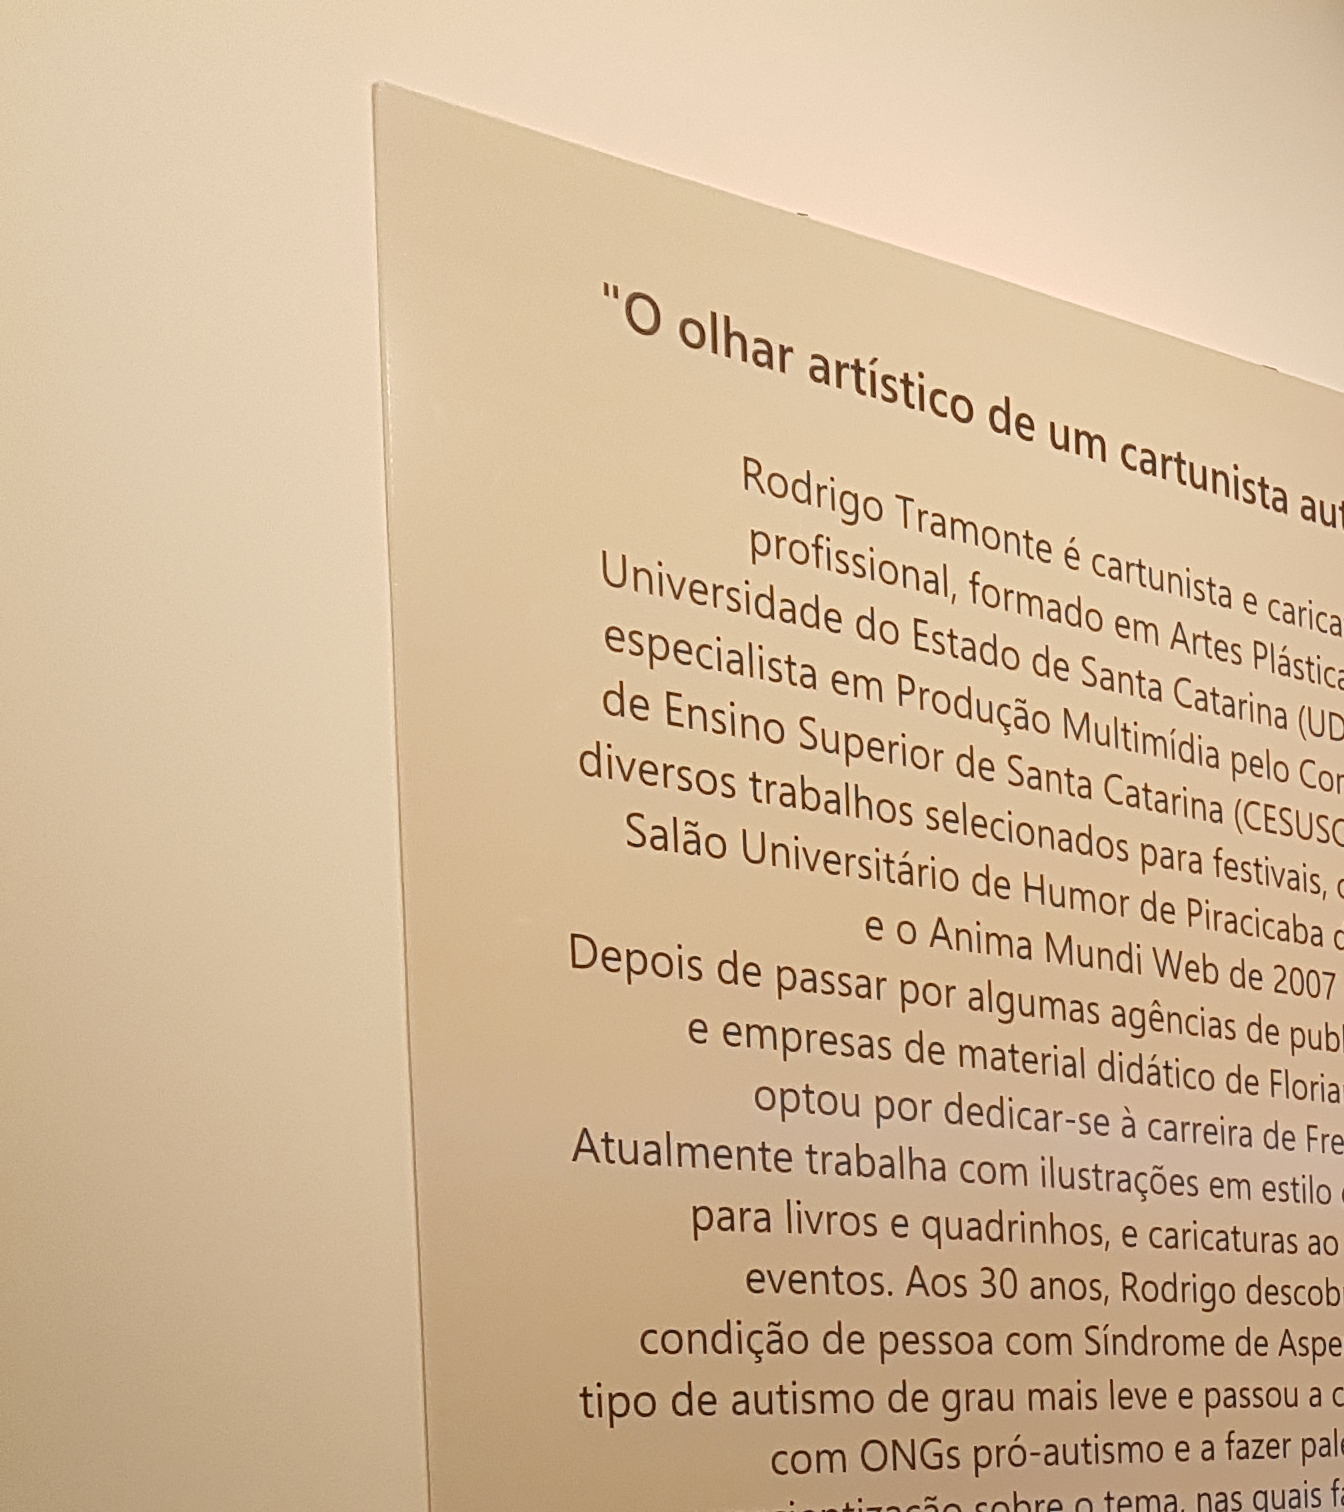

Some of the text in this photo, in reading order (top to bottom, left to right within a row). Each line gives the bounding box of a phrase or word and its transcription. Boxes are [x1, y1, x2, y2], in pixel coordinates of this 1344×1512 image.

[602, 280, 662, 337] "O
[677, 309, 795, 375] olhar
[807, 352, 975, 425] artístico
[987, 394, 1036, 443] de
[1048, 420, 1108, 464] um
[1119, 442, 1289, 516] cartunista
[742, 454, 884, 527] Rodrigo
[893, 492, 1053, 565] Tramonte
[1090, 552, 1233, 610] cartunista
[600, 549, 843, 635] Universidade
[854, 605, 900, 646] do
[912, 616, 1021, 672] Estado
[1080, 654, 1163, 703] Santa
[1172, 675, 1288, 731] Catarina
[749, 528, 957, 606] profissional,
[967, 569, 1104, 633] formado
[1113, 614, 1160, 647] em
[1168, 620, 1243, 667] Artes
[601, 679, 650, 722] de
[665, 689, 786, 745] Ensino
[797, 714, 945, 773] Superior
[954, 743, 996, 783] de
[1006, 753, 1093, 801] Santa
[1102, 772, 1224, 825] Catarina
[603, 624, 818, 691] especialista
[830, 668, 884, 704] em
[896, 672, 1052, 737] Produção
[1062, 706, 1220, 770] Multimídia
[1230, 747, 1290, 784] pelo
[578, 739, 737, 800] diversos
[747, 770, 914, 828] trabalhos
[924, 800, 1130, 863] selecionados
[1139, 841, 1203, 876] para
[1211, 845, 1328, 902] festivais,
[625, 811, 728, 860] Salão
[741, 827, 960, 893] Universitário
[1022, 870, 1131, 918] Humor
[1139, 888, 1177, 926] de
[1186, 896, 1325, 948] Piracicaba
[569, 931, 704, 986] Depois
[716, 948, 762, 989] de
[775, 964, 888, 1002] passar
[898, 978, 957, 1014] por
[967, 978, 1101, 1026] algumas
[1110, 998, 1237, 1042] agências
[1245, 1011, 1280, 1047] de
[928, 915, 1033, 962] Anima
[1044, 930, 1142, 976] Mundi
[1150, 945, 1220, 986] Web
[1272, 962, 1337, 1001] 2007
[721, 1020, 893, 1063] empresas
[957, 1042, 1086, 1080] material
[1096, 1048, 1216, 1092] didático
[1224, 1062, 1260, 1097] de
[570, 1126, 794, 1174] Atualmente
[803, 1141, 947, 1183] trabalha
[958, 1158, 1029, 1188] com
[1039, 1154, 1200, 1203] ilustrações
[1208, 1175, 1252, 1201] em
[1260, 1173, 1333, 1206] estilo
[753, 1082, 861, 1124] optou
[874, 1094, 933, 1130] por
[943, 1090, 1110, 1137] dedicar-se
[1146, 1114, 1253, 1149] carreira
[1262, 1118, 1297, 1152] de
[691, 1204, 772, 1243] para
[785, 1197, 879, 1238] livros
[920, 1207, 1111, 1253] quadrinhos,
[1147, 1218, 1299, 1256] caricaturas
[1306, 1233, 1340, 1257] ao
[744, 1264, 894, 1297] eventos.
[904, 1264, 968, 1299] Aos
[979, 1265, 1019, 1300] 30
[1028, 1275, 1110, 1307] anos,
[1120, 1270, 1236, 1314] Rodrigo
[638, 1317, 810, 1365] condição
[878, 1329, 994, 1366] pessoa
[1004, 1331, 1073, 1357] com
[1083, 1322, 1226, 1357] Síndrome
[1234, 1325, 1269, 1358] de
[577, 1380, 657, 1430] tipo
[670, 1379, 718, 1417] de
[730, 1378, 875, 1417] autismo
[940, 1387, 1015, 1423] grau
[1026, 1377, 1099, 1412] mais
[1108, 1377, 1168, 1411] leve
[1203, 1385, 1299, 1419] passou
[770, 1447, 848, 1477] com
[859, 1436, 962, 1473] ONGs
[972, 1432, 1165, 1479] pró-autismo
[1223, 1428, 1292, 1461] fazer
